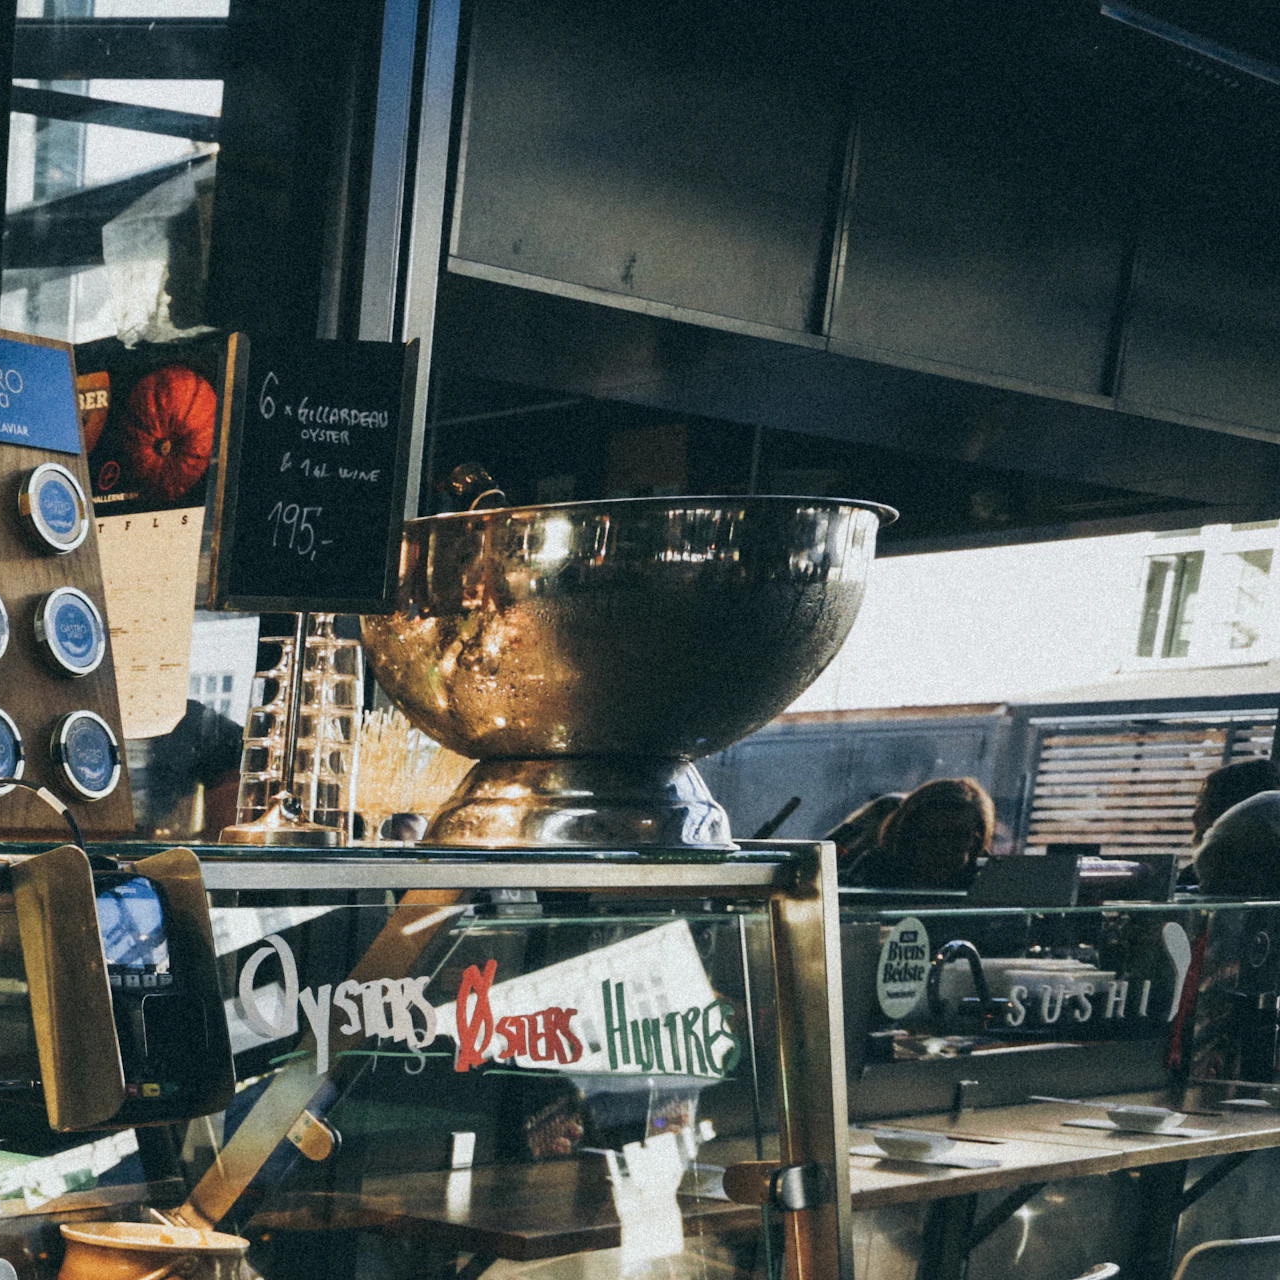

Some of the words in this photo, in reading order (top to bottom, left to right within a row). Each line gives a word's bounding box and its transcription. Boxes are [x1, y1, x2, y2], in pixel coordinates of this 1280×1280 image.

[260, 371, 278, 420] 6
[297, 395, 389, 430] GILLARDEAU
[300, 427, 351, 446] OYSTER
[338, 466, 382, 482] WINE
[1006, 979, 1152, 1027] SUSHI
